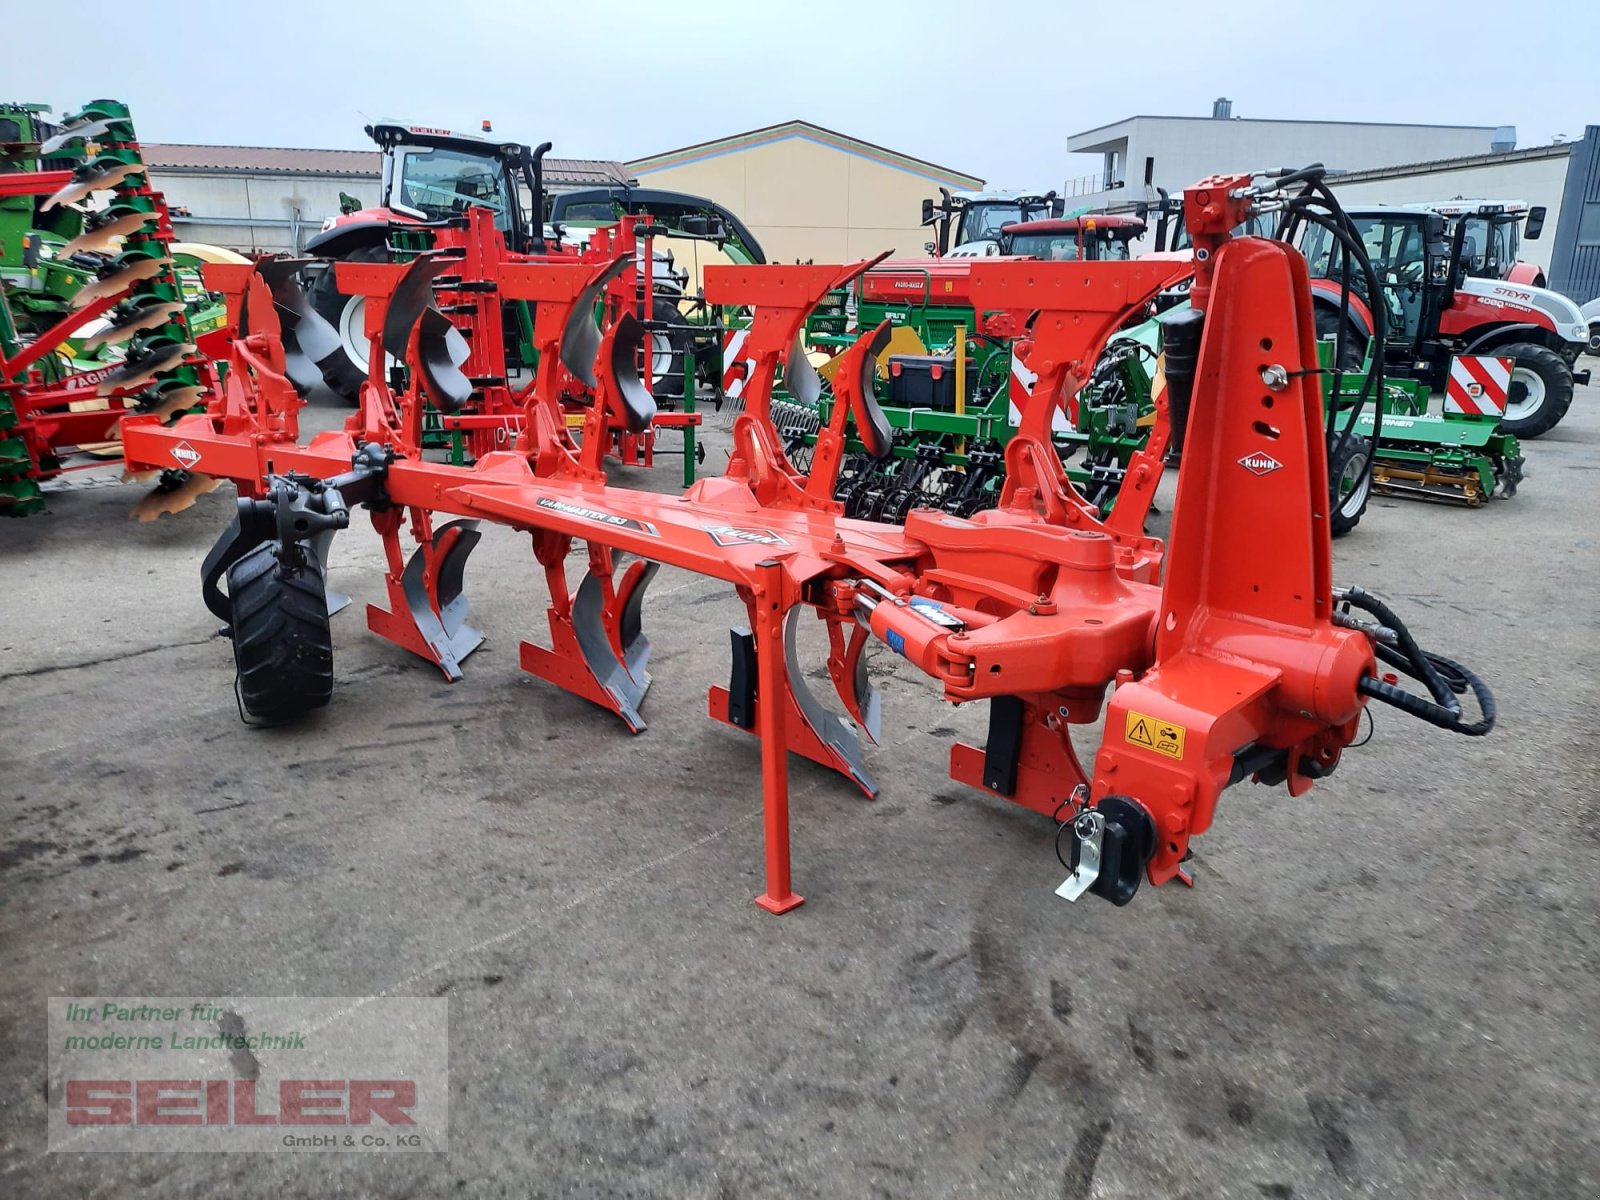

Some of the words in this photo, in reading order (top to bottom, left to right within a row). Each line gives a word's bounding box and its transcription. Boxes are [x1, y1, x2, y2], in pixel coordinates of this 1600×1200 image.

[1493, 287, 1531, 301] STEYR
[1368, 418, 1415, 428] KRNER
[1245, 458, 1275, 469] KUHN
[712, 526, 779, 544] KUHN
